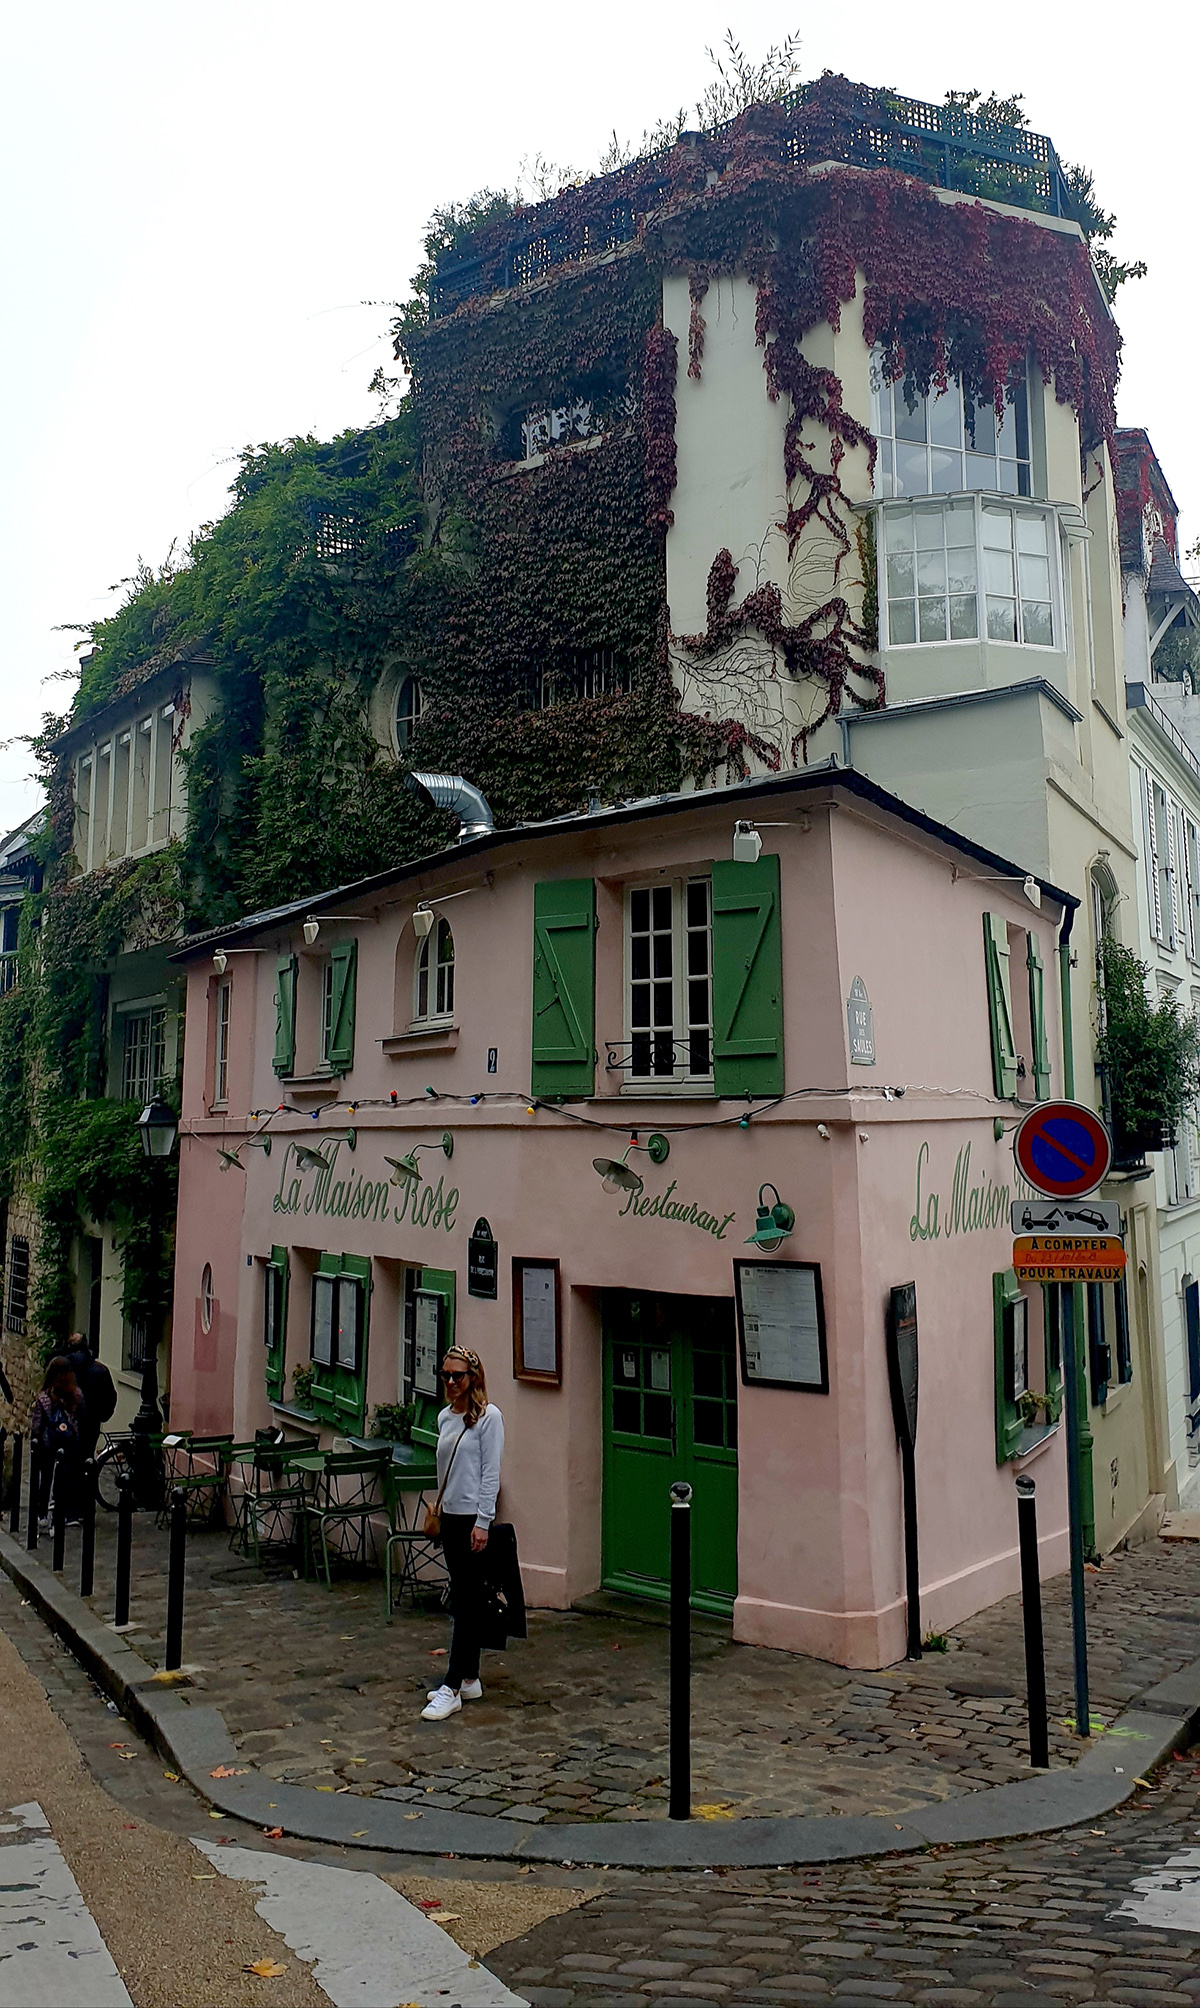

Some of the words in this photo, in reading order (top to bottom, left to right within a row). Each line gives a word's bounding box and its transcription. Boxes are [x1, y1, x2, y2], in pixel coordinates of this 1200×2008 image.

[855, 1010, 866, 1027] RUE
[273, 1141, 302, 1215] La
[303, 1141, 389, 1222] Maison
[394, 1153, 459, 1233] Rose
[909, 1141, 941, 1242] La
[945, 1140, 1010, 1239] Maison
[618, 1175, 736, 1241] Restaurant
[1044, 1239, 1108, 1251] COMPTER
[1020, 1267, 1055, 1279] POUR
[1061, 1267, 1121, 1279] TRAVAUX
